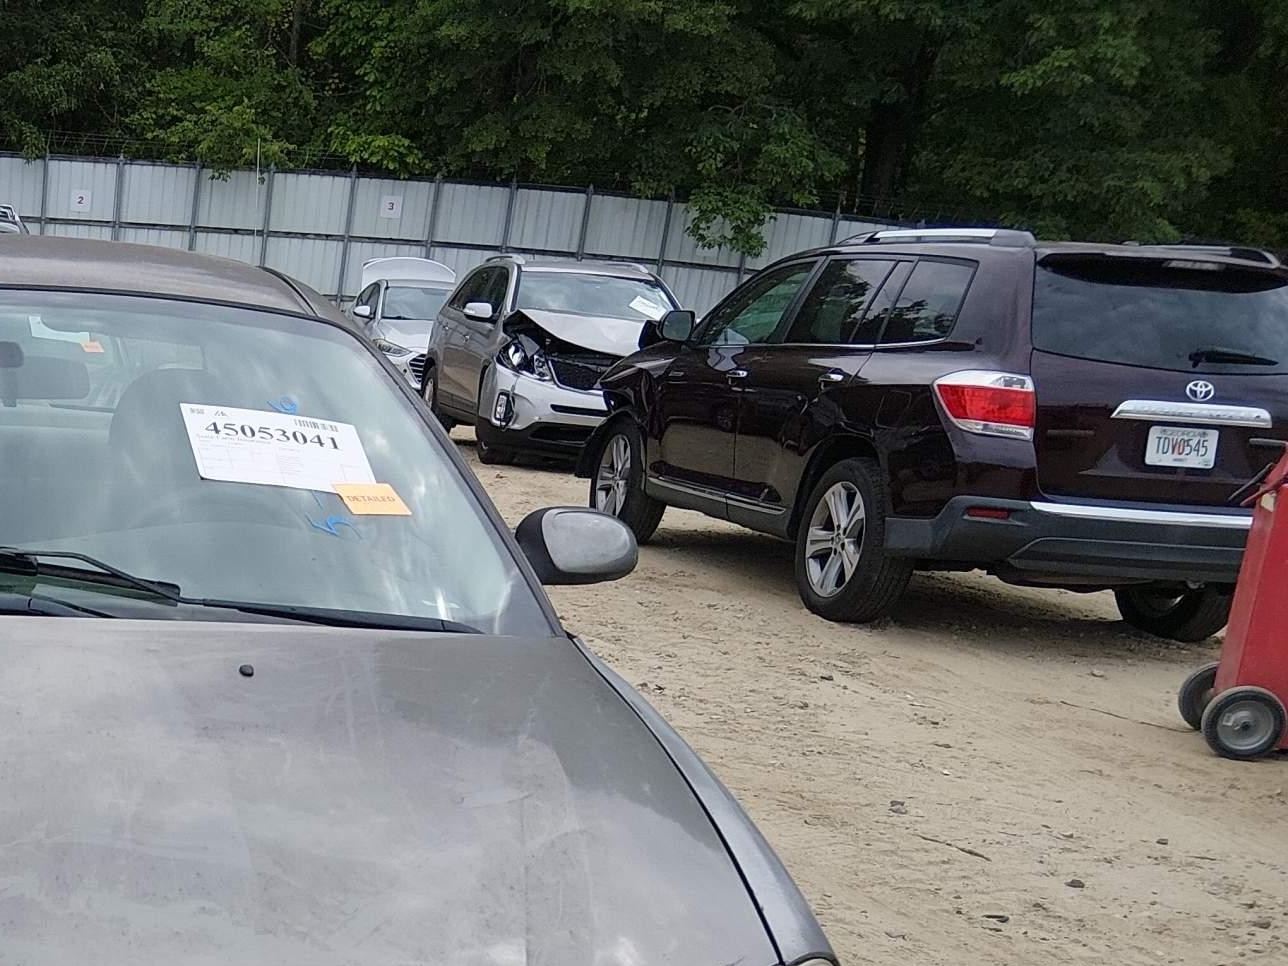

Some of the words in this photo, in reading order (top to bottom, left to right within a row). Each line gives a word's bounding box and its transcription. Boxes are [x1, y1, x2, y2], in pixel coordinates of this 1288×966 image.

[77, 195, 85, 205] 2
[387, 201, 395, 211] 3
[205, 420, 342, 451] 45053041
[1155, 436, 1209, 457] TDV0545
[345, 495, 396, 503] DETAILED
